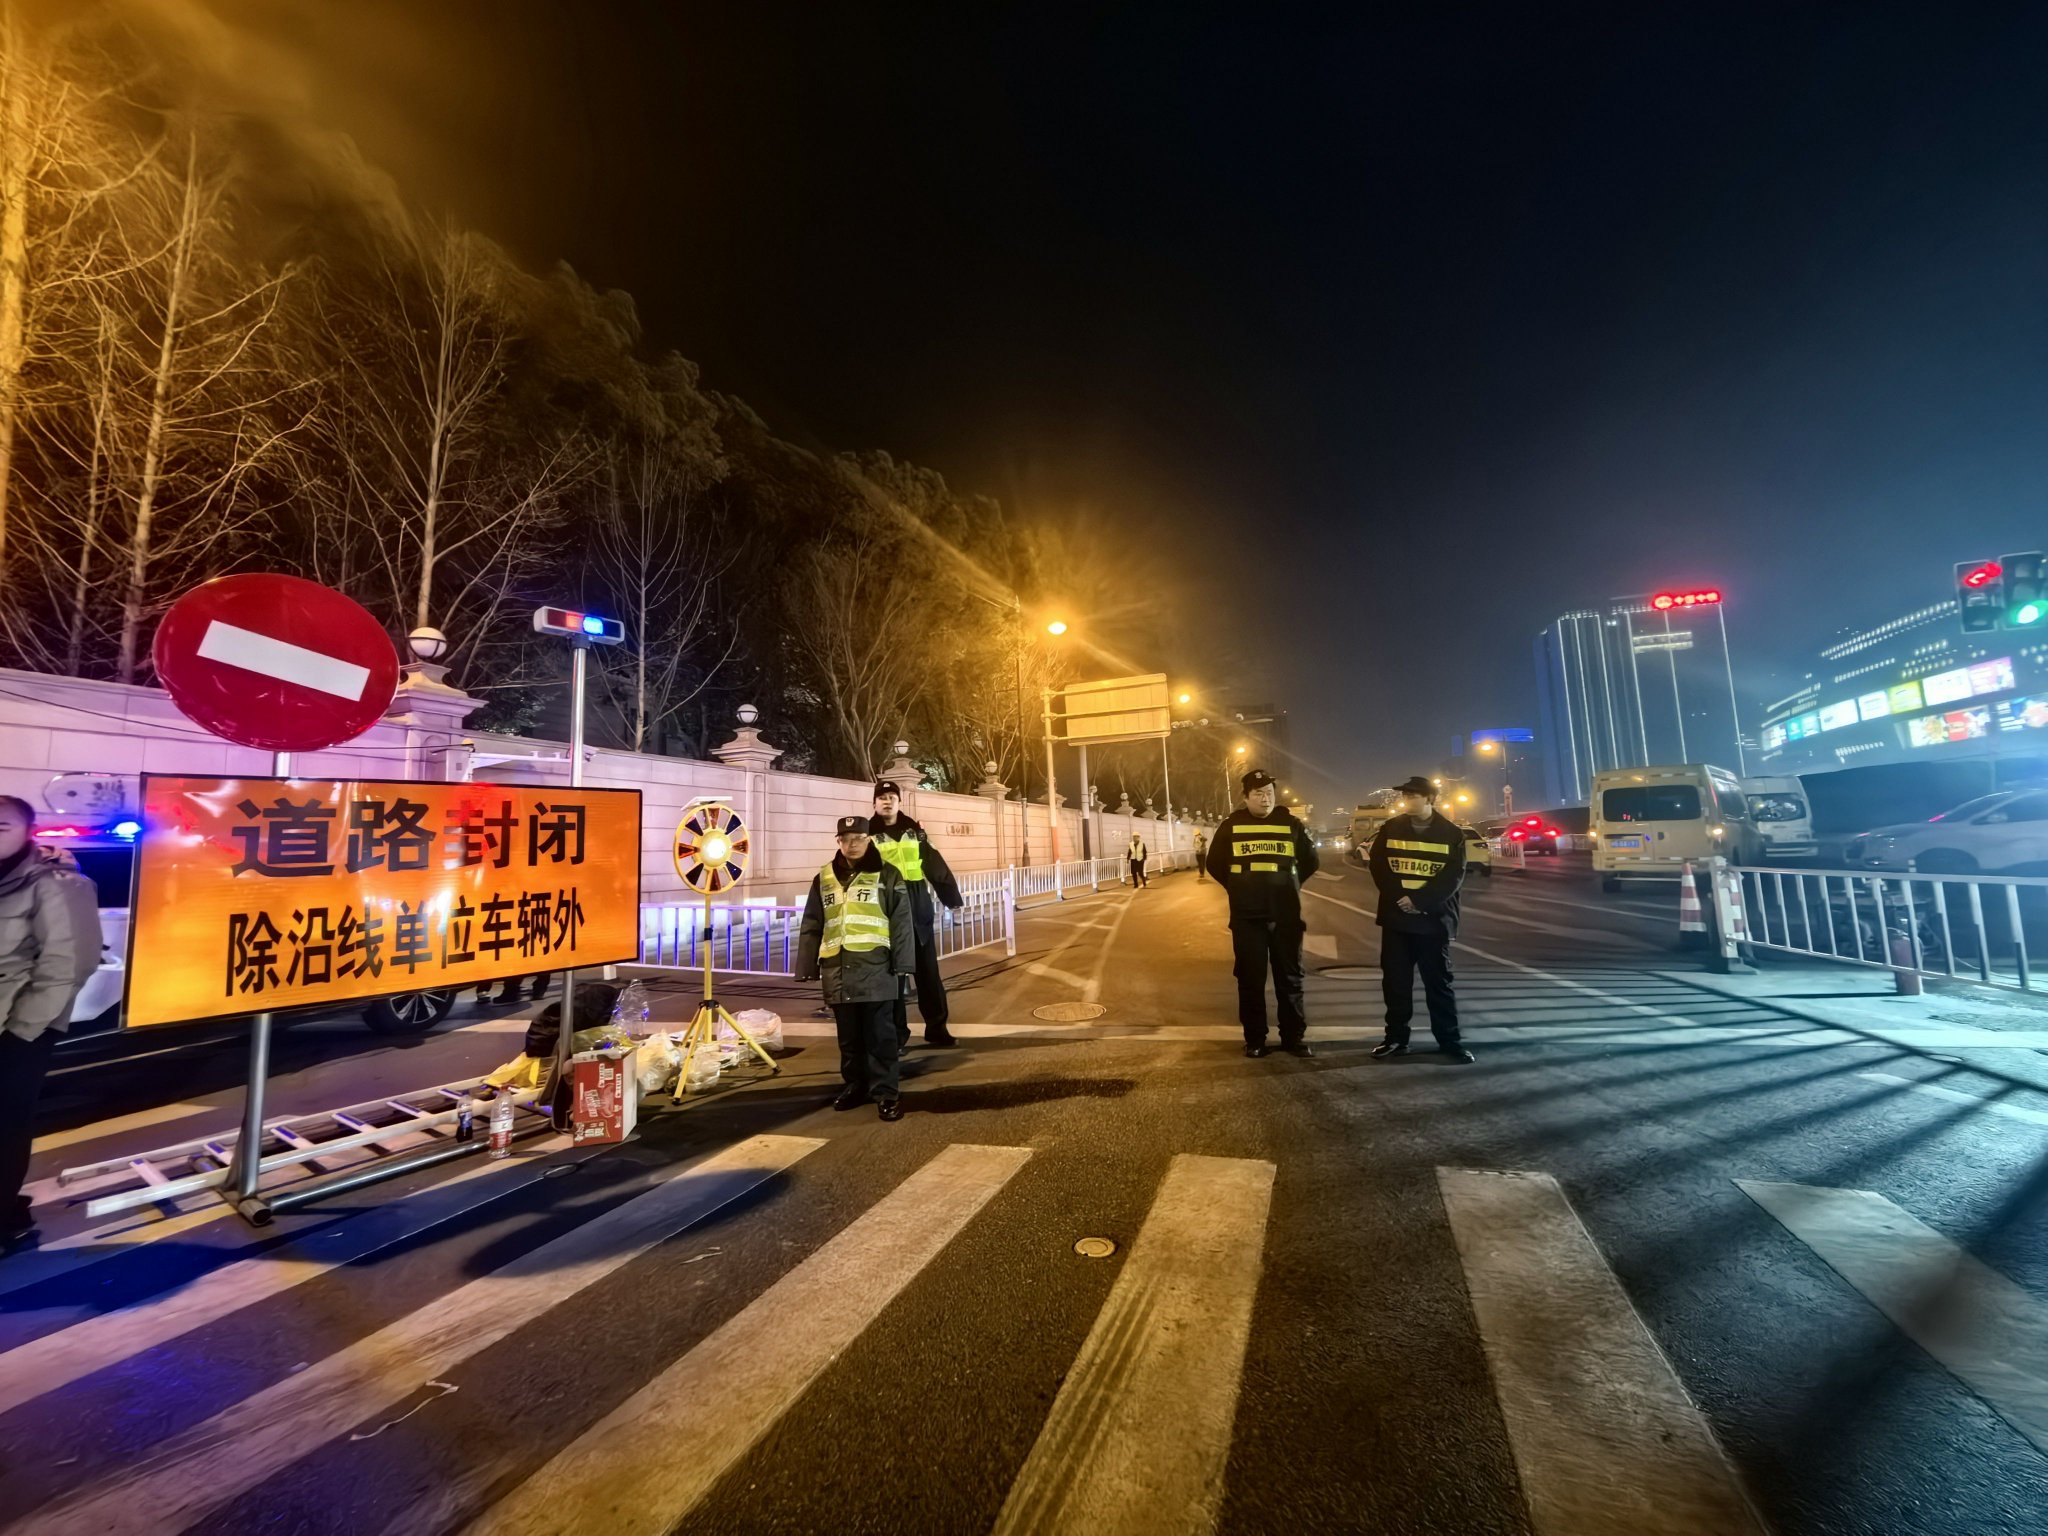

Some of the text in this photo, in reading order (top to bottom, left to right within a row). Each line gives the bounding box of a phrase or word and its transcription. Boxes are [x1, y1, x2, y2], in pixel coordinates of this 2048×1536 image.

[231, 797, 587, 879] 道路封闭
[225, 886, 585, 997] 除沿线单位车辆外
